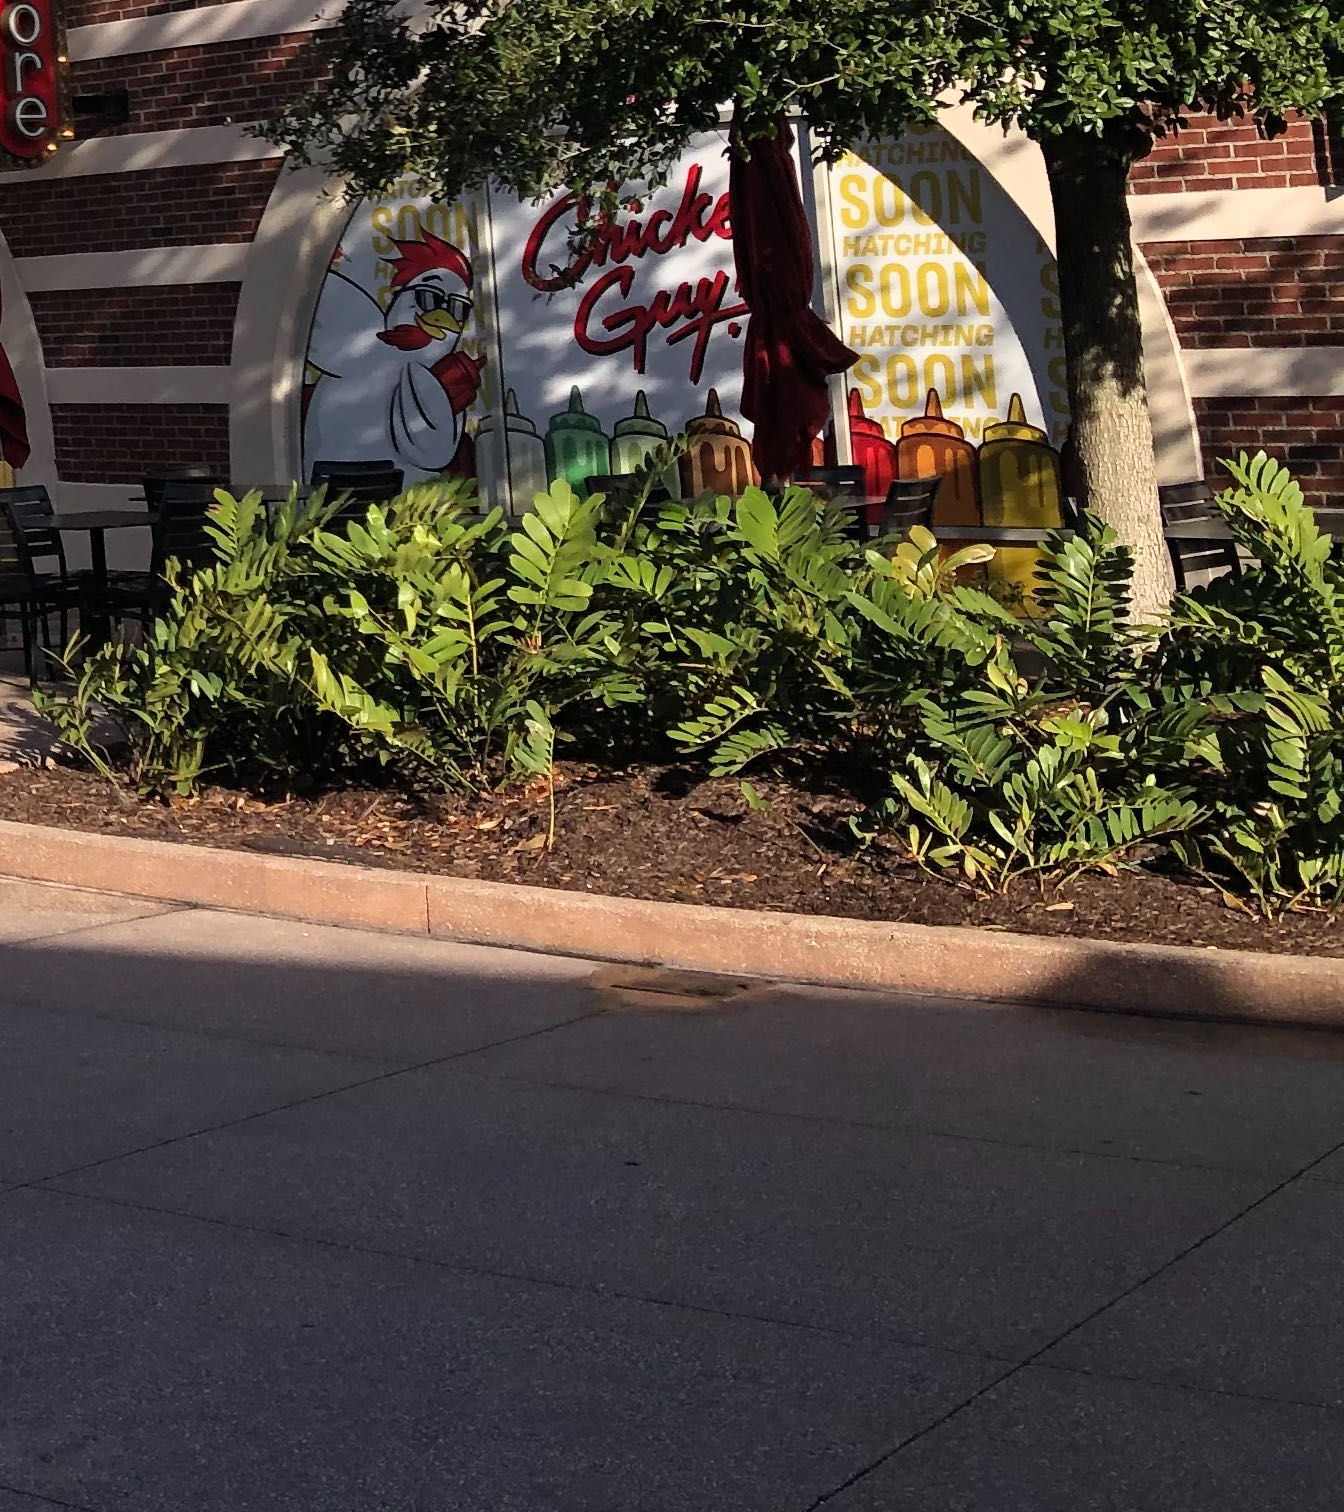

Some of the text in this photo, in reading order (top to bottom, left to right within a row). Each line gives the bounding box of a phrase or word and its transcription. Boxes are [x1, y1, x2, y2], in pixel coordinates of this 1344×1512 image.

[840, 168, 984, 229] SOON
[522, 163, 736, 292] Chicke
[842, 231, 988, 257] HATCHING
[845, 262, 992, 319] SOON
[849, 324, 995, 347] HATCHING
[850, 354, 999, 410] SOON
